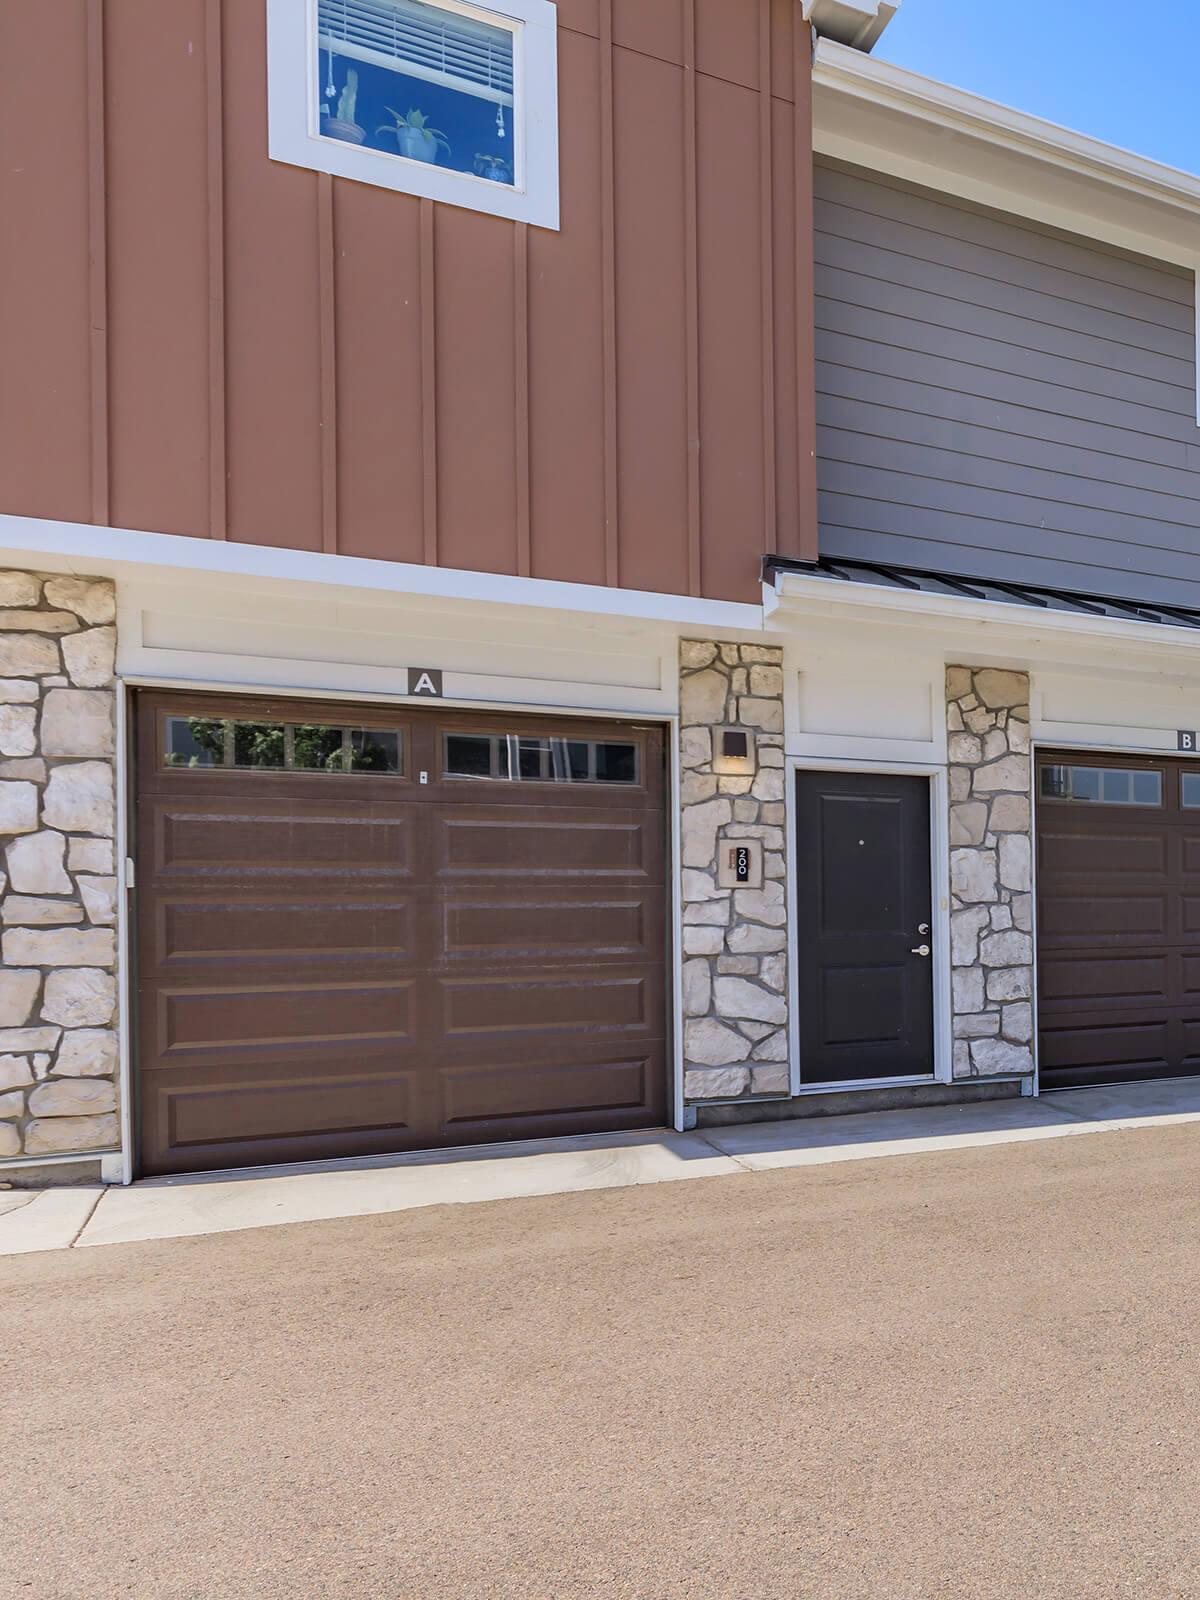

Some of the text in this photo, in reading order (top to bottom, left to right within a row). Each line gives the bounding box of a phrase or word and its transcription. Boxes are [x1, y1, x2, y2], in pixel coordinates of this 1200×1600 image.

[413, 672, 437, 694] A
[1182, 733, 1192, 749] B
[738, 849, 747, 875] 200
